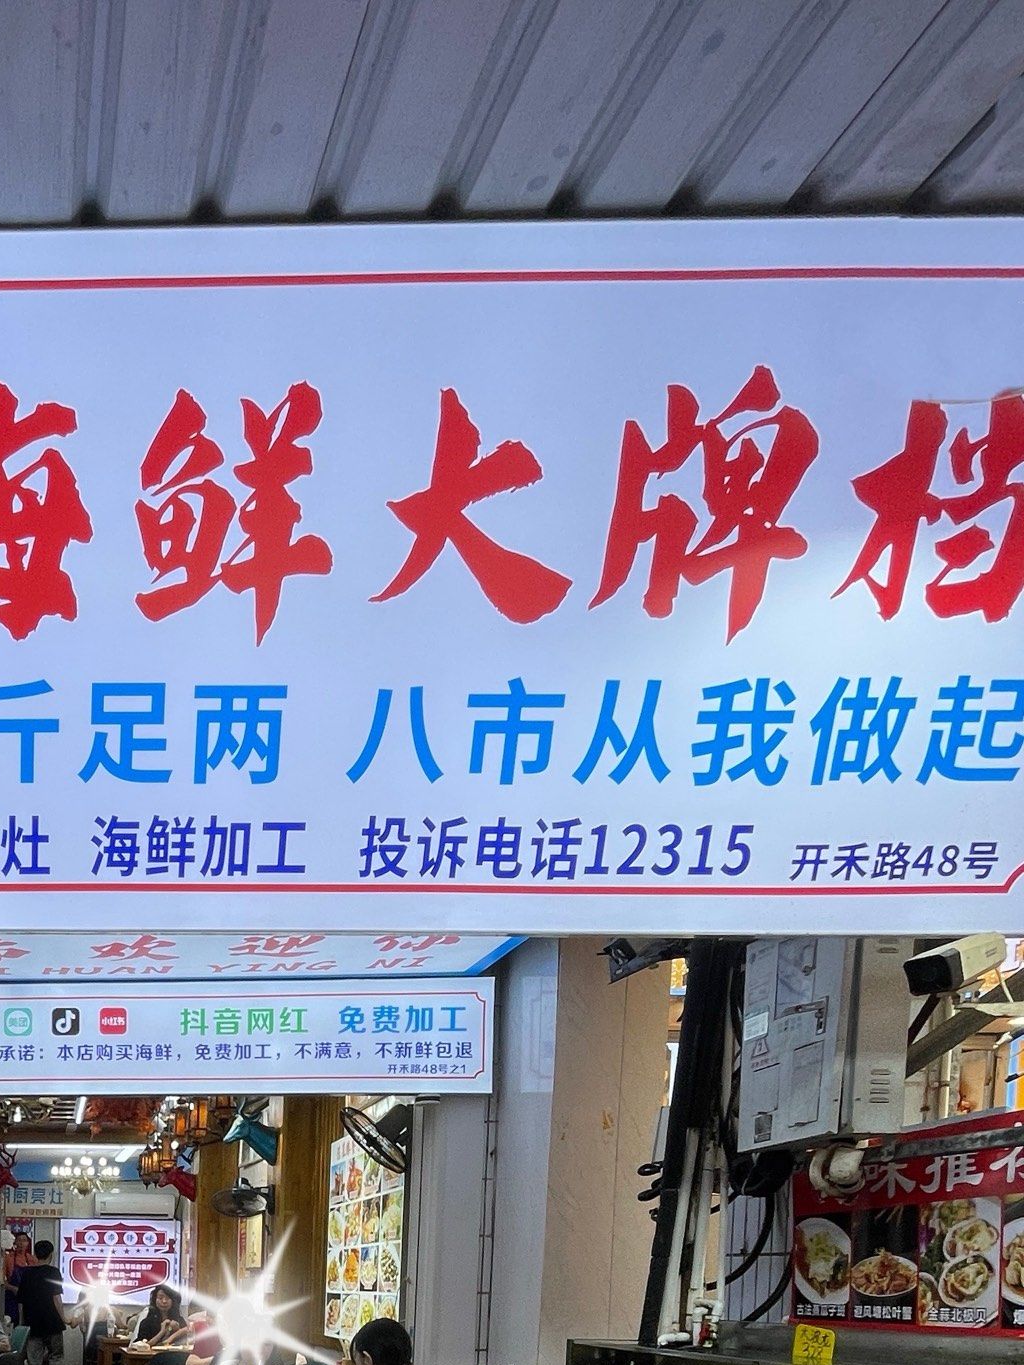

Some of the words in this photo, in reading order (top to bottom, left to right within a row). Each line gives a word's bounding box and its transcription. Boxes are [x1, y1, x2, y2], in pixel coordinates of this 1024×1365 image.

[346, 676, 1024, 788] 八市从我做起
[90, 815, 307, 878] 海鲜加工
[359, 815, 755, 881] 投诉电话12315
[789, 842, 1000, 882] 开禾路48号
[42, 965, 175, 975] HUAN
[207, 960, 338, 973] YING
[365, 955, 434, 969] NI
[180, 1006, 309, 1036] 抖音网红
[338, 1005, 468, 1034] 免费加工
[387, 1063, 468, 1075] 开禾路48号之1
